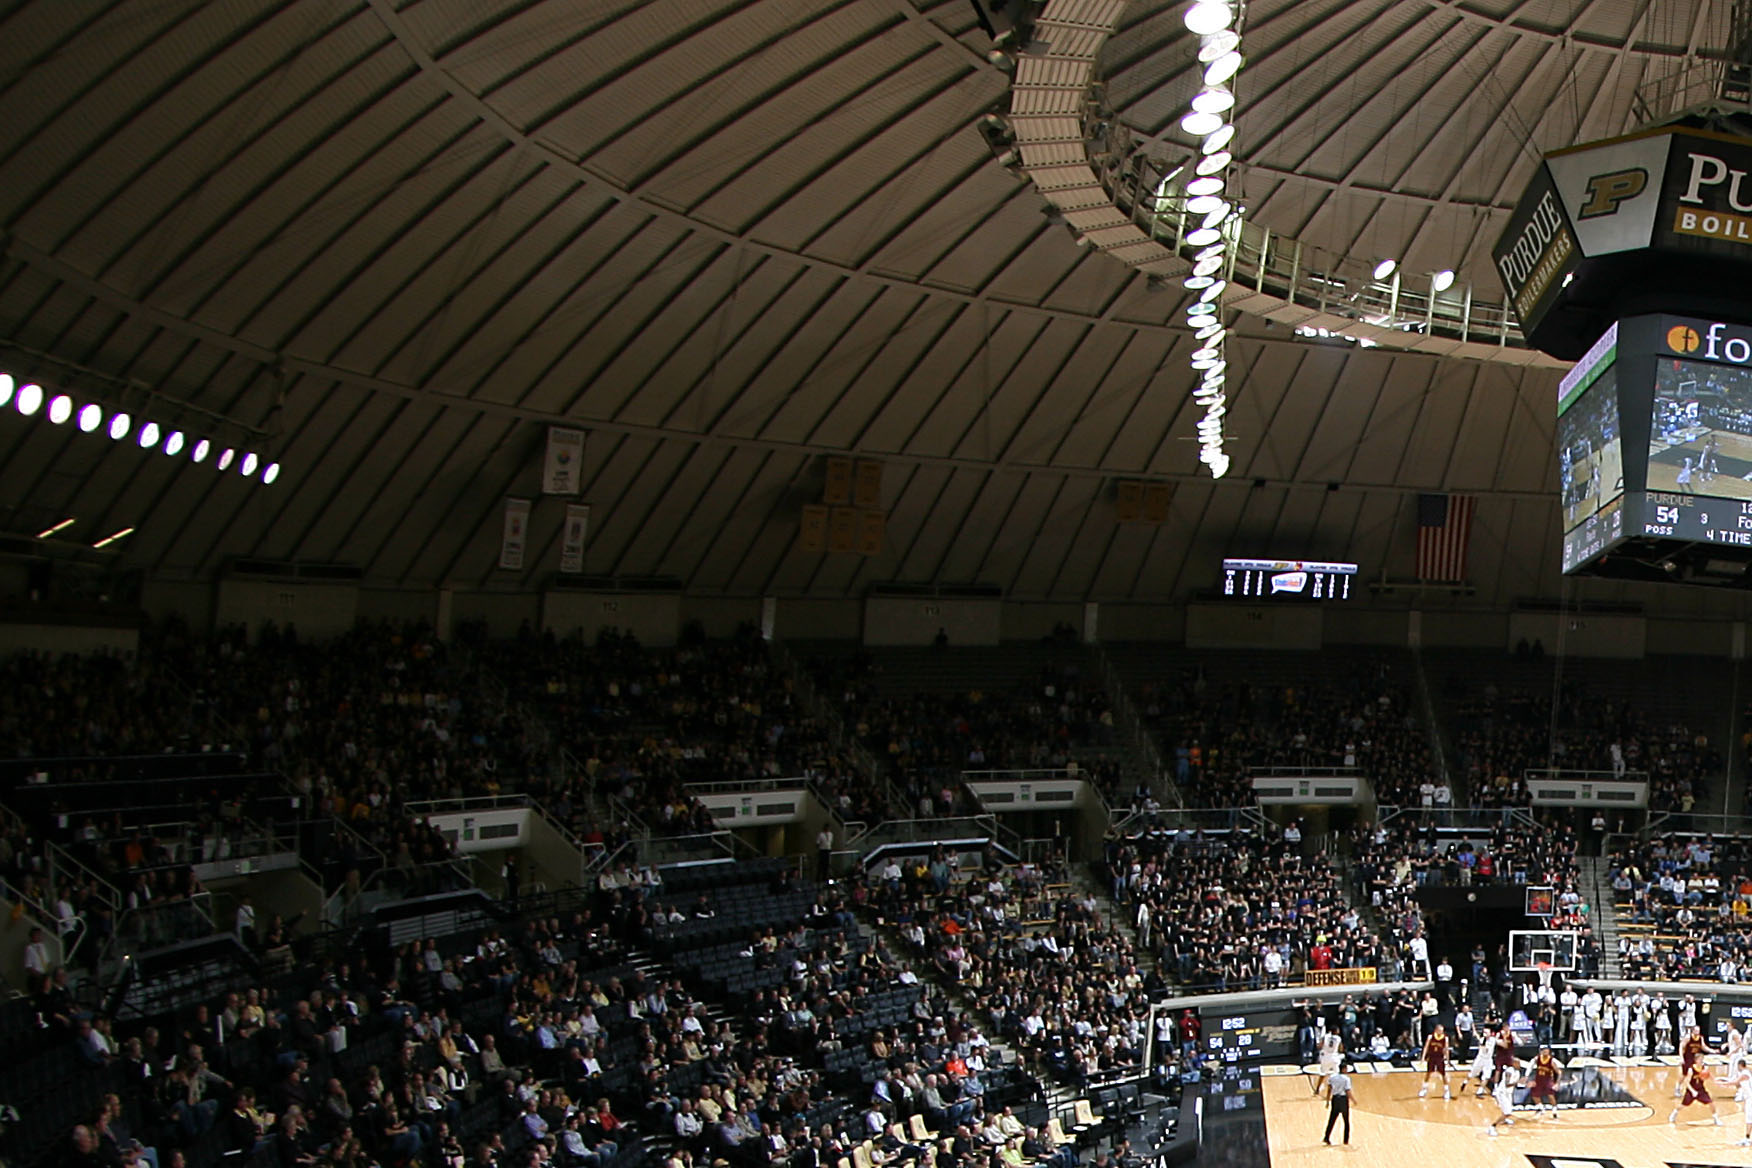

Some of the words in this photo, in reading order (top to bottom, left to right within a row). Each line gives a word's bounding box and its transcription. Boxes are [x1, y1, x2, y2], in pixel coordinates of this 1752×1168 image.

[1576, 168, 1649, 221] P
[1499, 190, 1562, 298] PURDUE
[1515, 232, 1572, 318] BOILERMAKERS
[1645, 492, 1695, 508] PURDUE
[1656, 506, 1680, 524] 54
[1700, 513, 1709, 525] 3
[1644, 523, 1674, 536] POSS
[1706, 529, 1715, 541] 4
[1720, 530, 1752, 546] TIME
[1306, 969, 1346, 987] DEFENSE
